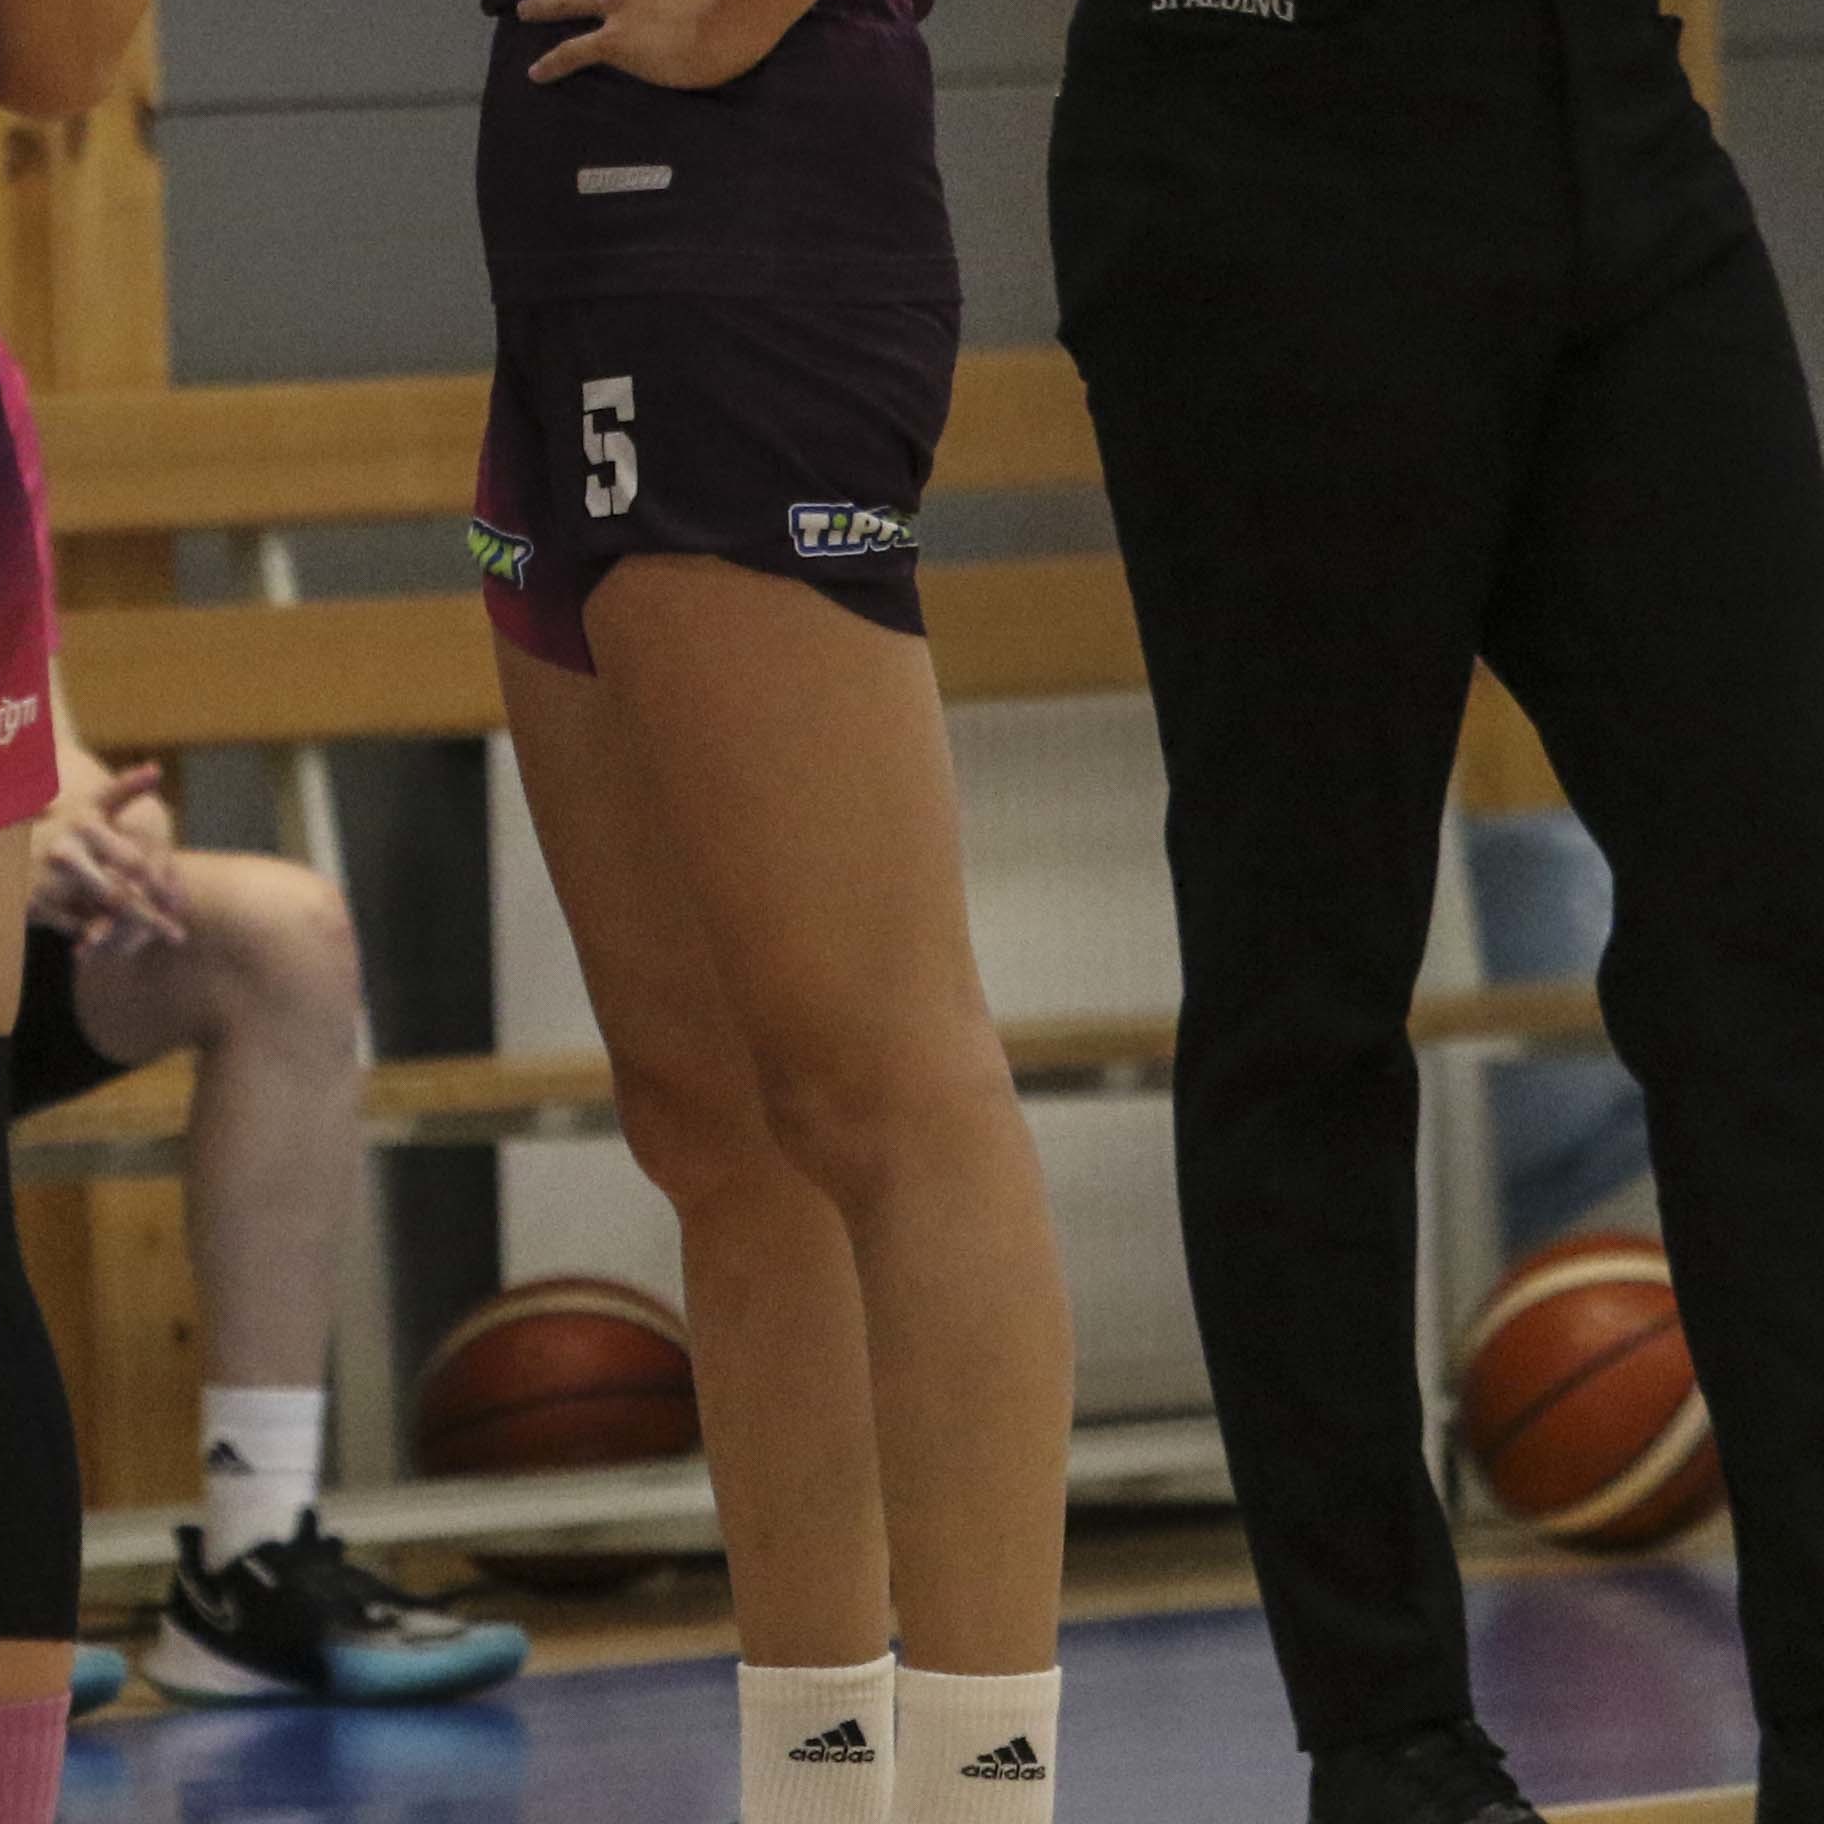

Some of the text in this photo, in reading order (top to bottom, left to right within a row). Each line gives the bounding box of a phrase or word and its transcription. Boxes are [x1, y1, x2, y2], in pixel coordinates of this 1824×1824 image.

[581, 376, 639, 519] 5
[787, 1743, 877, 1764] adidas
[960, 1761, 1047, 1782] adidas
